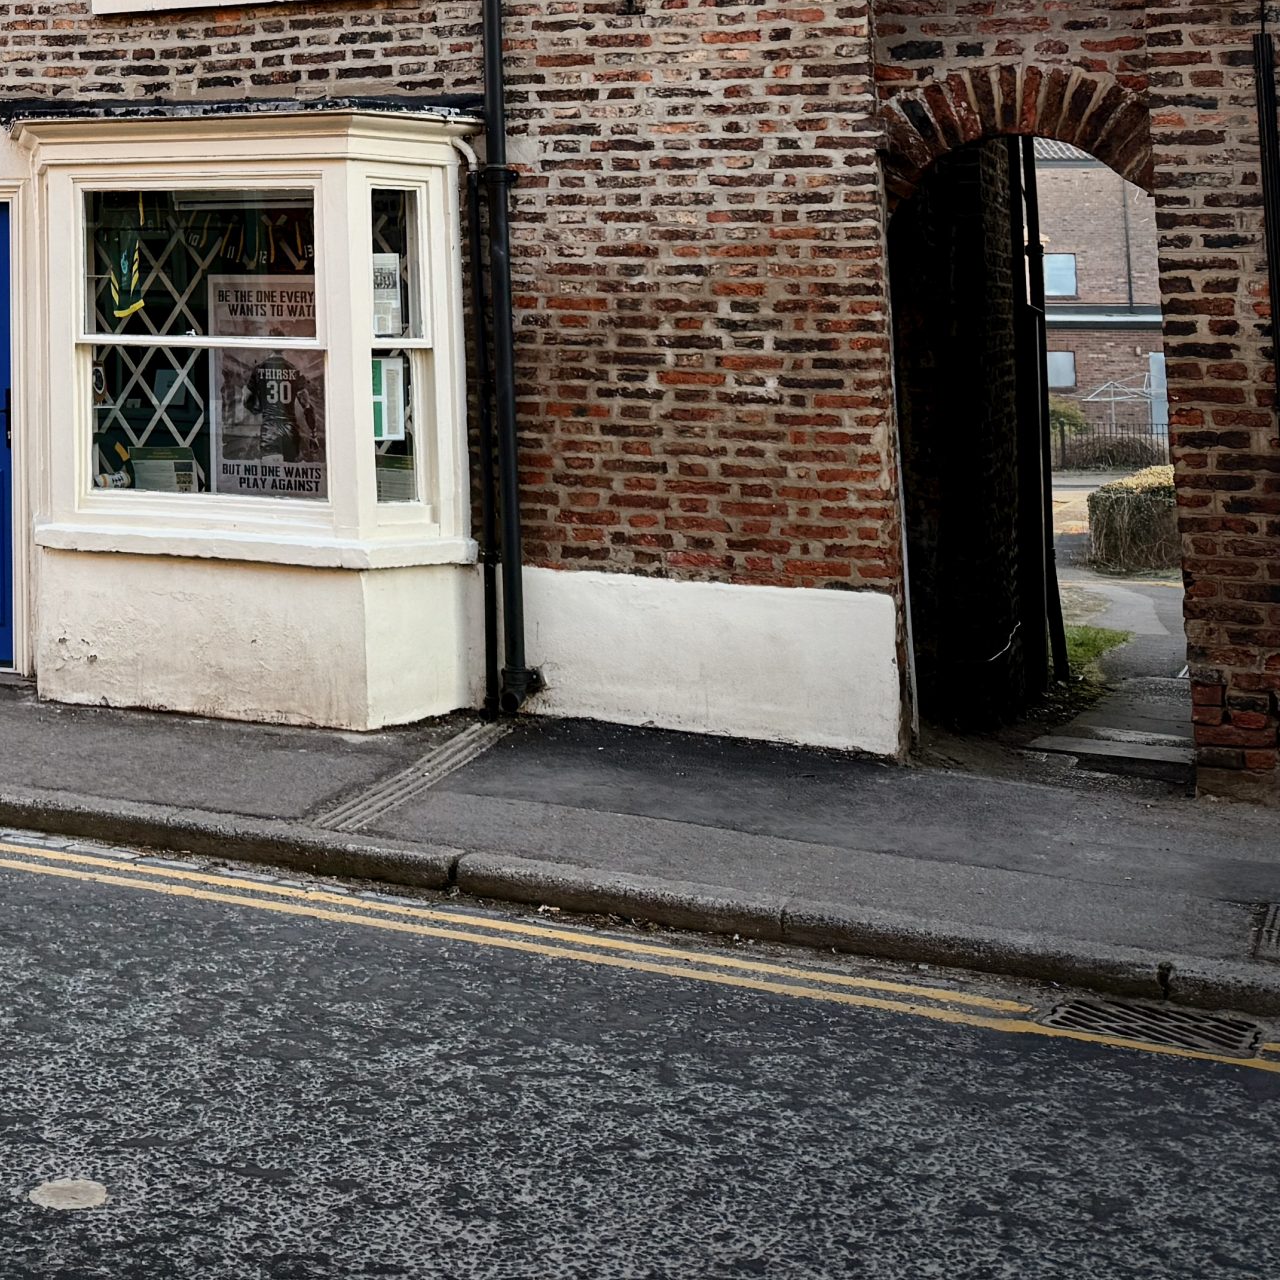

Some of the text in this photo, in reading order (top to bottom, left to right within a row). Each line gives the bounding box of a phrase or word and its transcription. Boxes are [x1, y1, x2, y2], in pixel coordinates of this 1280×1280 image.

[218, 289, 231, 303] BE
[233, 289, 253, 303] THE
[256, 290, 277, 303] ONE
[228, 303, 267, 317] WANTS
[270, 304, 283, 317] TO
[257, 368, 296, 380] THIRSK
[266, 380, 292, 404] 30
[222, 463, 322, 480] BUT NO ONE WANTS
[239, 477, 320, 492] PLAY AGAINST
